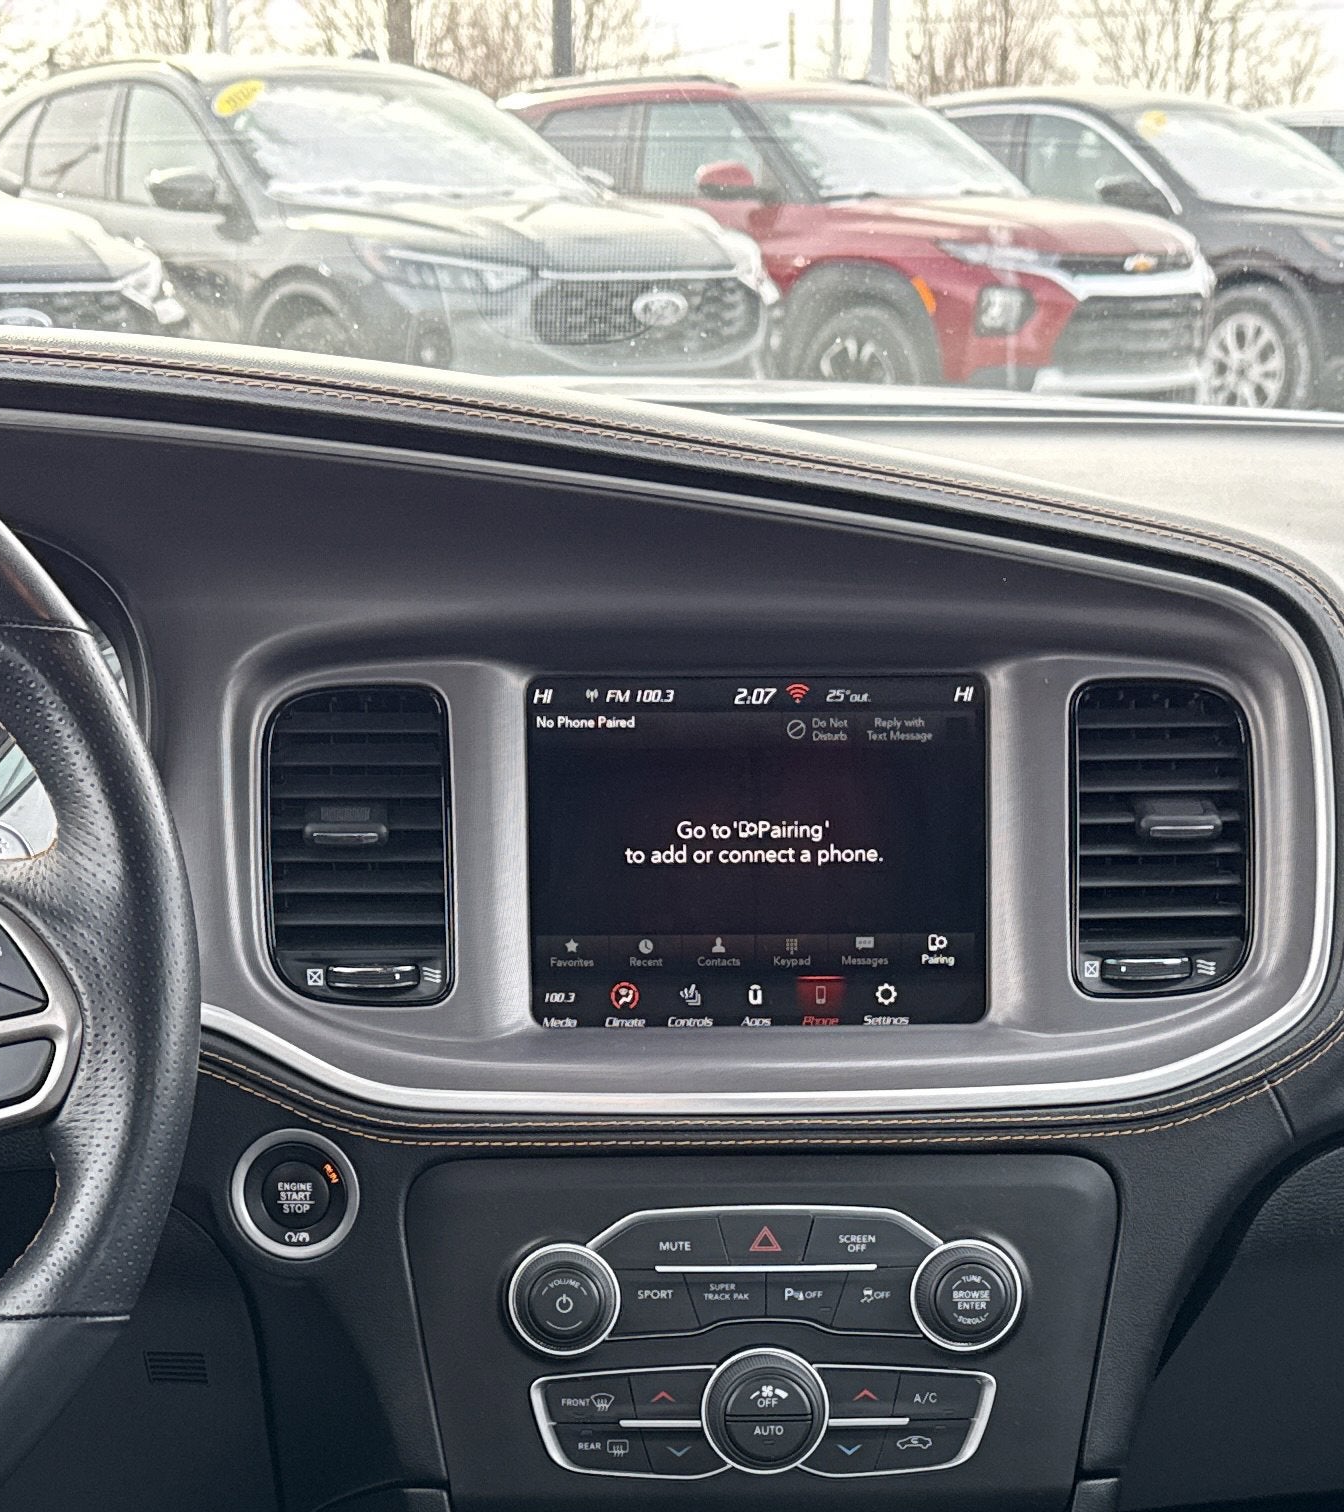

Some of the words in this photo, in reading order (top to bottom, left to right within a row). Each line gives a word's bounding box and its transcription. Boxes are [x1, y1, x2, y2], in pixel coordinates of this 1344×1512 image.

[532, 688, 554, 705] HI
[605, 689, 631, 703] FM
[636, 689, 675, 704] 100.3
[733, 687, 778, 705] 2:07
[953, 685, 975, 703] HI
[536, 716, 555, 729] No
[557, 716, 595, 729] Phone
[598, 715, 636, 729] Paired
[811, 718, 827, 729] Do
[830, 718, 848, 728] Not
[874, 717, 902, 730] Reply
[904, 717, 925, 728] with
[812, 731, 848, 742] Disturb
[866, 731, 888, 742] Text
[890, 731, 933, 743] Message
[676, 820, 706, 840] Go
[711, 824, 732, 840] to
[624, 847, 646, 864] to
[650, 843, 687, 864] add
[692, 850, 714, 864] or
[718, 846, 796, 864] connect
[799, 850, 812, 863] a
[817, 843, 884, 867] phone.
[550, 956, 595, 968] Favorites
[629, 956, 664, 968] Recent
[696, 955, 741, 967] Contacts
[773, 955, 812, 969] Keypad
[841, 955, 889, 968] Messages
[921, 953, 956, 967] Pairing
[544, 991, 576, 1003] 100.3
[542, 1016, 578, 1028] Media
[605, 1016, 647, 1028] Climate
[667, 1016, 714, 1028] Controls
[802, 1015, 840, 1026] Phone
[277, 1181, 313, 1192] ENGINE
[279, 1191, 312, 1201] START
[282, 1203, 311, 1214] STOP
[838, 1234, 876, 1244] SCREEN
[659, 1241, 692, 1252] MUTE
[847, 1244, 867, 1253] OFF
[548, 1278, 582, 1290] VOLUME
[961, 1274, 983, 1285] TUNE
[709, 1283, 736, 1292] SUPER
[637, 1289, 673, 1300] SPORT
[704, 1293, 731, 1301] TRACK
[733, 1293, 750, 1301] PAK
[805, 1290, 824, 1300] OFF
[874, 1290, 892, 1300] OFF
[952, 1289, 991, 1299] BROWSE
[957, 1301, 987, 1311] ENTER
[956, 1314, 988, 1326] SCROLL
[560, 1397, 591, 1408] FRONT
[757, 1398, 779, 1408] OFF
[913, 1391, 938, 1405] A/C
[753, 1425, 785, 1436] AUTO
[577, 1441, 602, 1452] REAR
